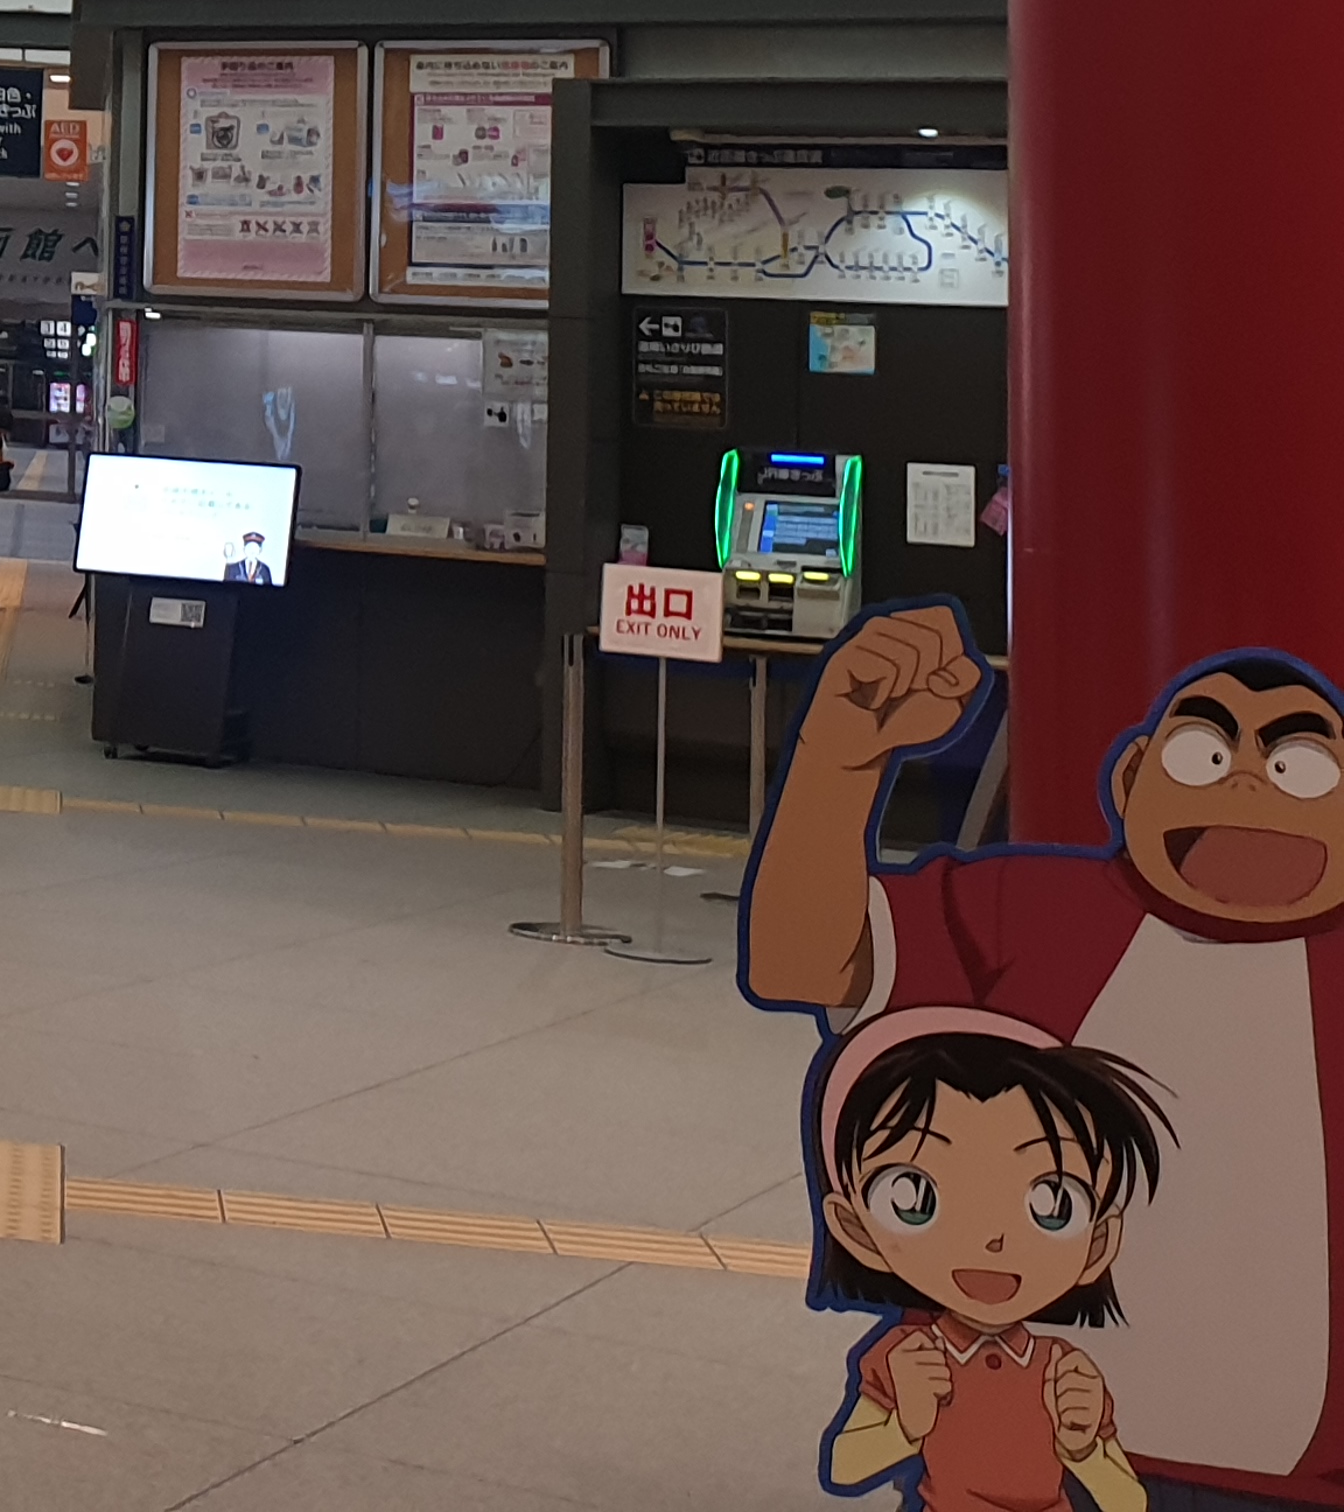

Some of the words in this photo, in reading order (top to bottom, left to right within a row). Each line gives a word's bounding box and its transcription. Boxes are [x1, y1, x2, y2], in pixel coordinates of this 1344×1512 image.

[50, 122, 80, 135] AED
[624, 583, 693, 621] 出口
[615, 619, 652, 636] EXIT
[656, 623, 703, 641] ONLY
